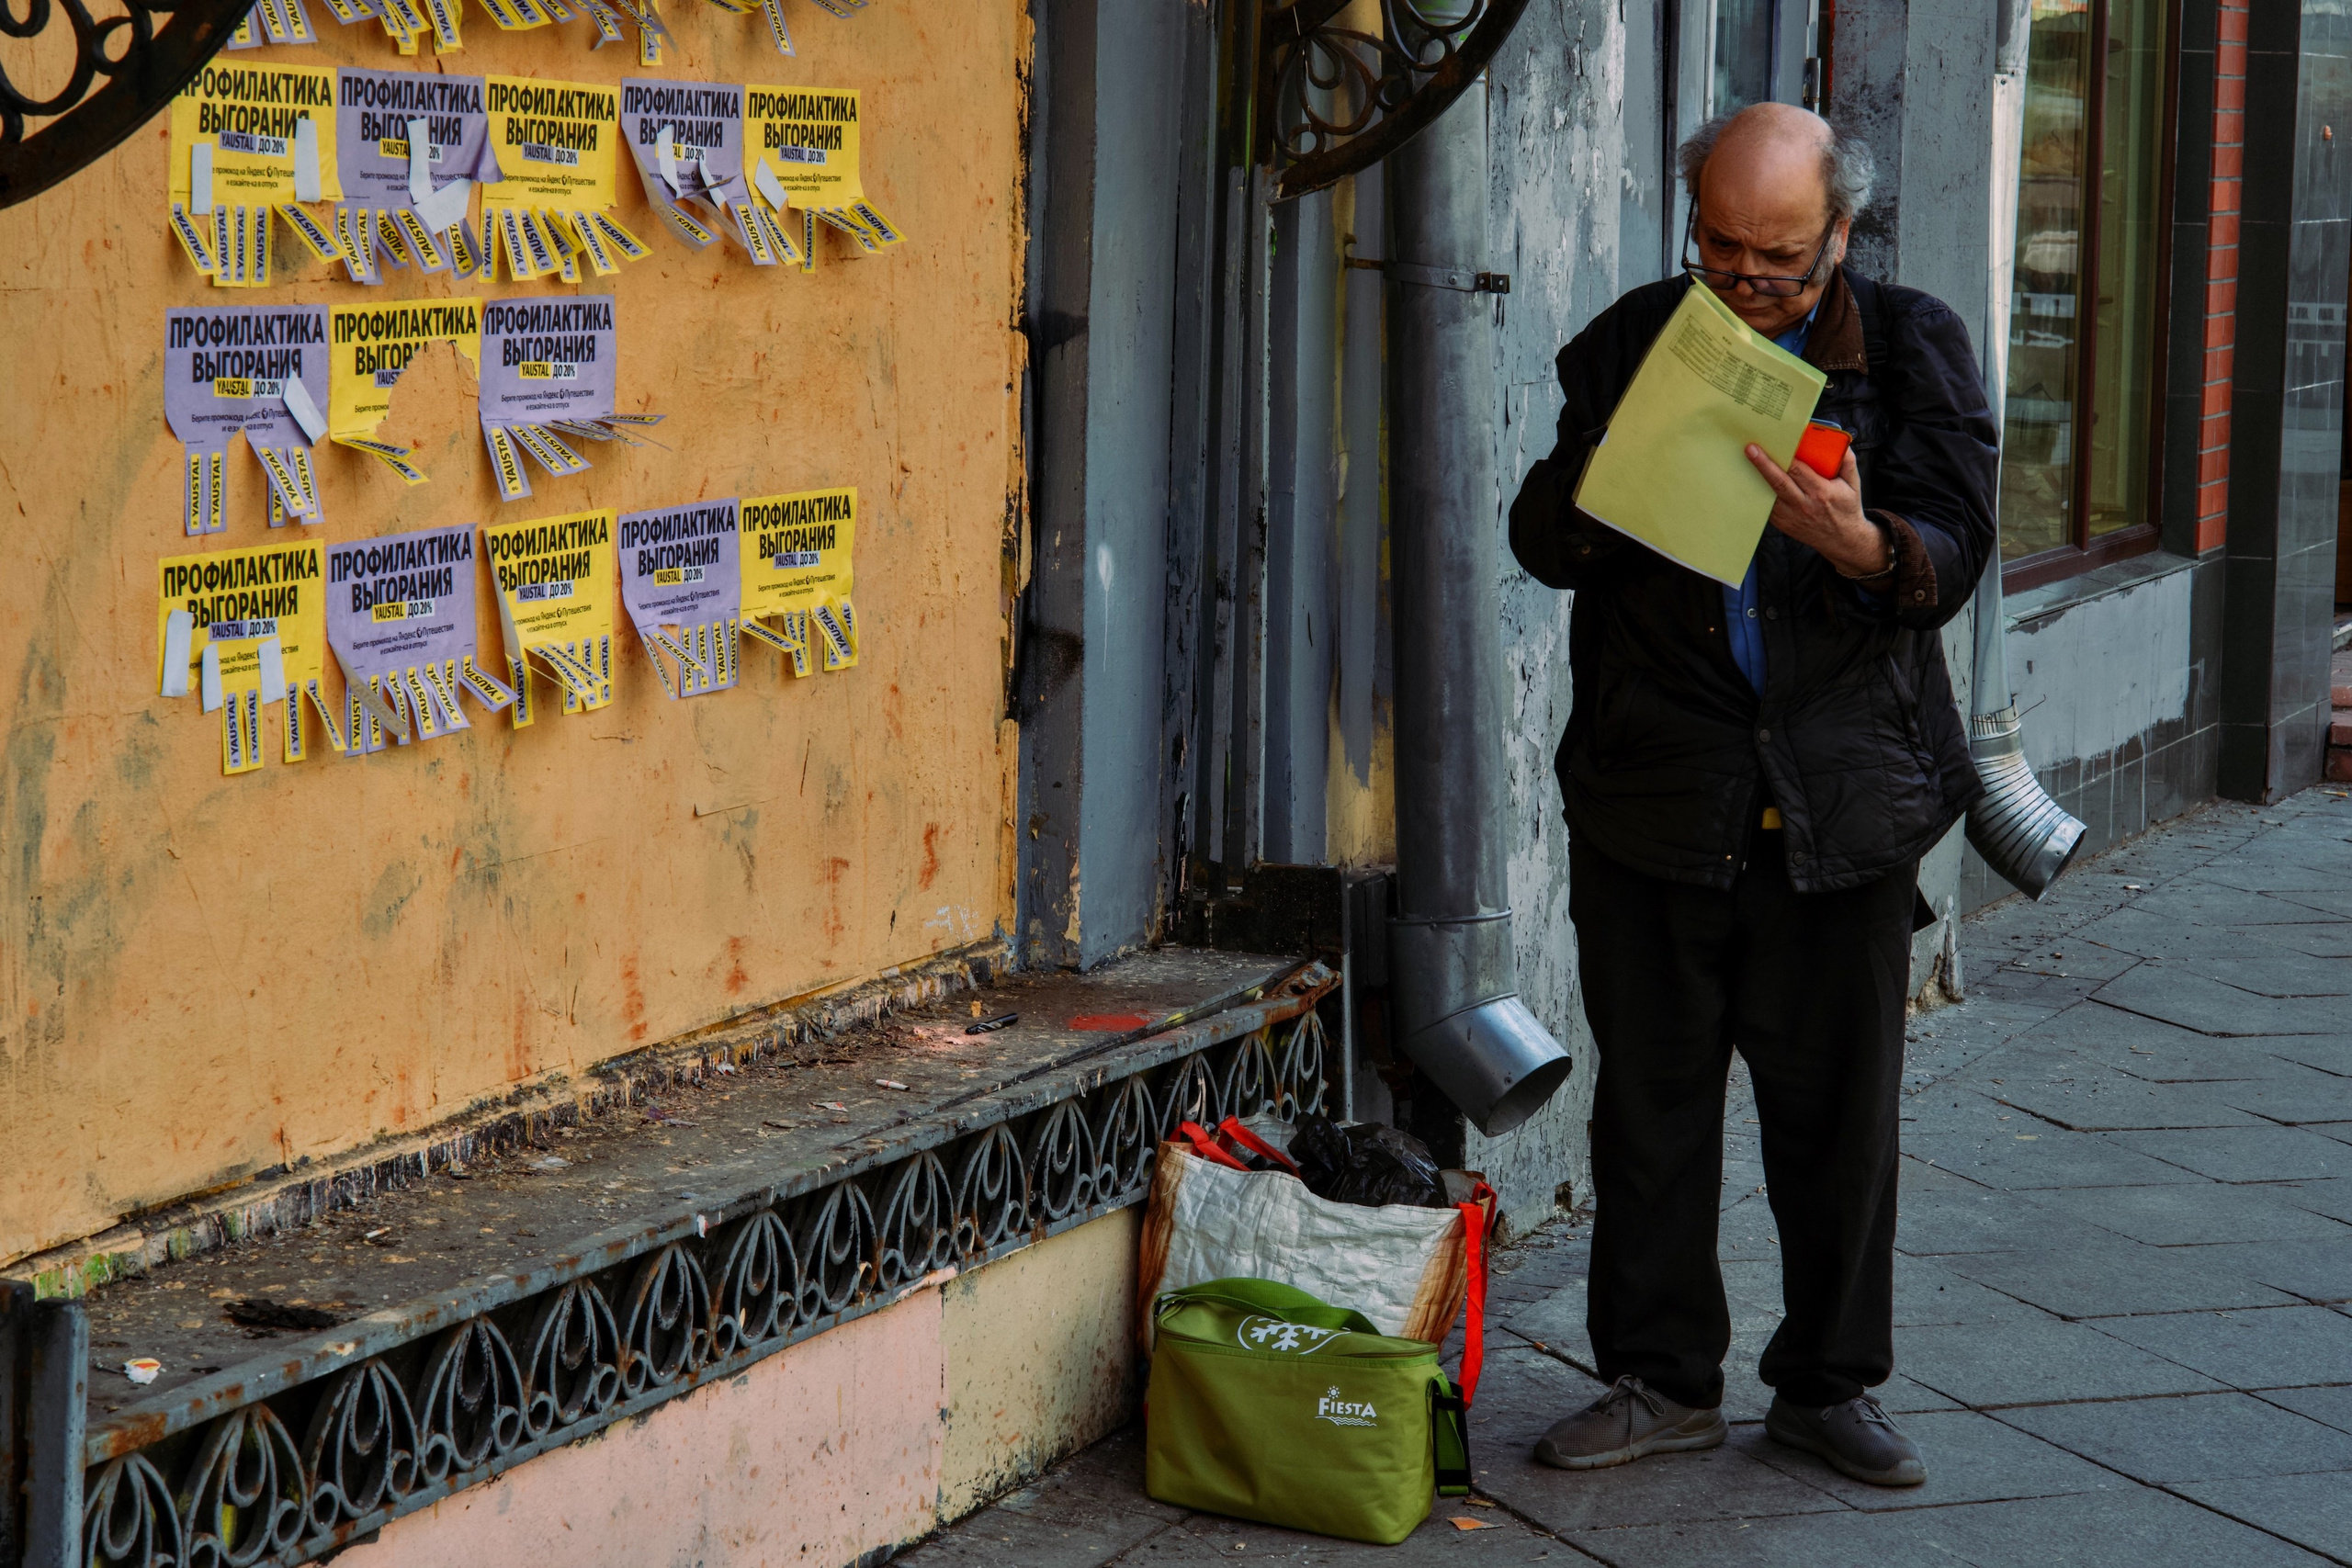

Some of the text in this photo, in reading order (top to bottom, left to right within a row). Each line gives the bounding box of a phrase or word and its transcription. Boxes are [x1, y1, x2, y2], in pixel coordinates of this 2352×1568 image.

[342, 76, 483, 113] ПРОФИЛАКТИКА
[488, 83, 615, 121] ПРОФИЛАКТИКА
[624, 86, 740, 118] ПРОФИЛАКТИКА
[749, 93, 856, 122] ПРОФИЛАКТИКА
[199, 103, 310, 139] ВЫГОРАНИ
[361, 112, 462, 146] ВЫГОНИЯ
[506, 117, 597, 151] ВЫГОРАНИЯ
[764, 123, 842, 150] ВЫГОРАНИЯ
[220, 132, 285, 154] YAUSTAL ДО 20%
[429, 146, 440, 160] 20%
[524, 144, 577, 164] YAUSTAL ДО 20%
[684, 147, 694, 161] ДО
[781, 147, 825, 164] YAUSTAL ДО 20%
[567, 177, 596, 186] Путешествия
[175, 208, 204, 258] YAUSTAL
[218, 209, 229, 267] YAUSTAL
[288, 206, 327, 250] YAUSTAL
[379, 214, 404, 254] YAUSTAL
[402, 212, 434, 258] YAUSTAL
[522, 214, 547, 260] YAUSTAL
[578, 214, 603, 260] YAUSTAL
[595, 215, 632, 249] YAUSTAL
[741, 208, 763, 252] YAUSTAL
[857, 206, 888, 235] YAUSTAL
[256, 211, 265, 269] YAUSTAL
[340, 212, 359, 265] YAUSTAL
[505, 213, 523, 264] YAUSTAL
[170, 313, 324, 348] ПРОФИЛАКТИКА
[334, 306, 476, 344] ПРОФИЛАКТИКА
[485, 303, 612, 334] ПРОФИЛАКТИКА
[192, 348, 302, 383] ВЫГОРАНИЯ
[355, 340, 457, 376] ВЫГОР
[503, 335, 595, 367] ВЫГОРАНИЯ
[522, 364, 575, 378] YAUSTAL ДО 20%
[217, 381, 280, 397] YAUSTAL ДО 20%
[543, 391, 559, 400] Яндекс
[565, 389, 594, 399] Путешествия
[495, 432, 517, 484] YAUSTAL
[517, 429, 554, 465] YAUSTAL
[533, 427, 572, 460] YAUSTAL
[265, 451, 297, 500] YAUSTAL
[621, 505, 735, 549] ПРОФИЛАКТИКА
[743, 494, 851, 532] ПРОФИЛАКТИКА
[332, 532, 471, 582] ПРОФИЛАКТИКА
[639, 537, 718, 577] ВЫГОРАНИЯ
[760, 525, 835, 559] ВЫГОРАНИЯ
[775, 552, 819, 567] YAUSTAL ДО 20%
[164, 548, 319, 598] ПРОФИЛАКТИКА
[499, 550, 590, 592] ВЫГОРАНИЯ
[657, 568, 703, 583] YAUSTAL ДО 20%
[187, 585, 298, 629] ВЫГОРАНИЯ
[352, 567, 452, 613] ВЫГОРАНИЯ
[518, 582, 571, 601] YAUSTAL ДО 20%
[375, 601, 432, 620] YAUSTAL ДО 20%
[562, 604, 592, 617] Путешествия
[211, 620, 275, 638] YAUSTAL ДО 20%
[399, 631, 415, 642] Яндекс
[423, 624, 454, 637] Путешествия
[746, 623, 785, 644] YAUSTAL
[819, 608, 846, 649] YAUSTAL
[237, 651, 255, 662] Яндекс
[538, 649, 577, 683] YAUSTAL
[552, 647, 592, 677] YAUSTAL
[659, 635, 695, 667] YAUSTAL
[715, 626, 725, 674] YAUSTAL
[427, 667, 455, 714] YAUSTAL
[464, 660, 494, 696] YAUSTAL
[409, 671, 429, 722] YAUSTAL
[229, 697, 238, 755] YAUSTAL
[289, 687, 298, 744] YAUSTAL
[353, 694, 361, 739] YAUST
[1317, 1397, 1377, 1417] FIESTA
